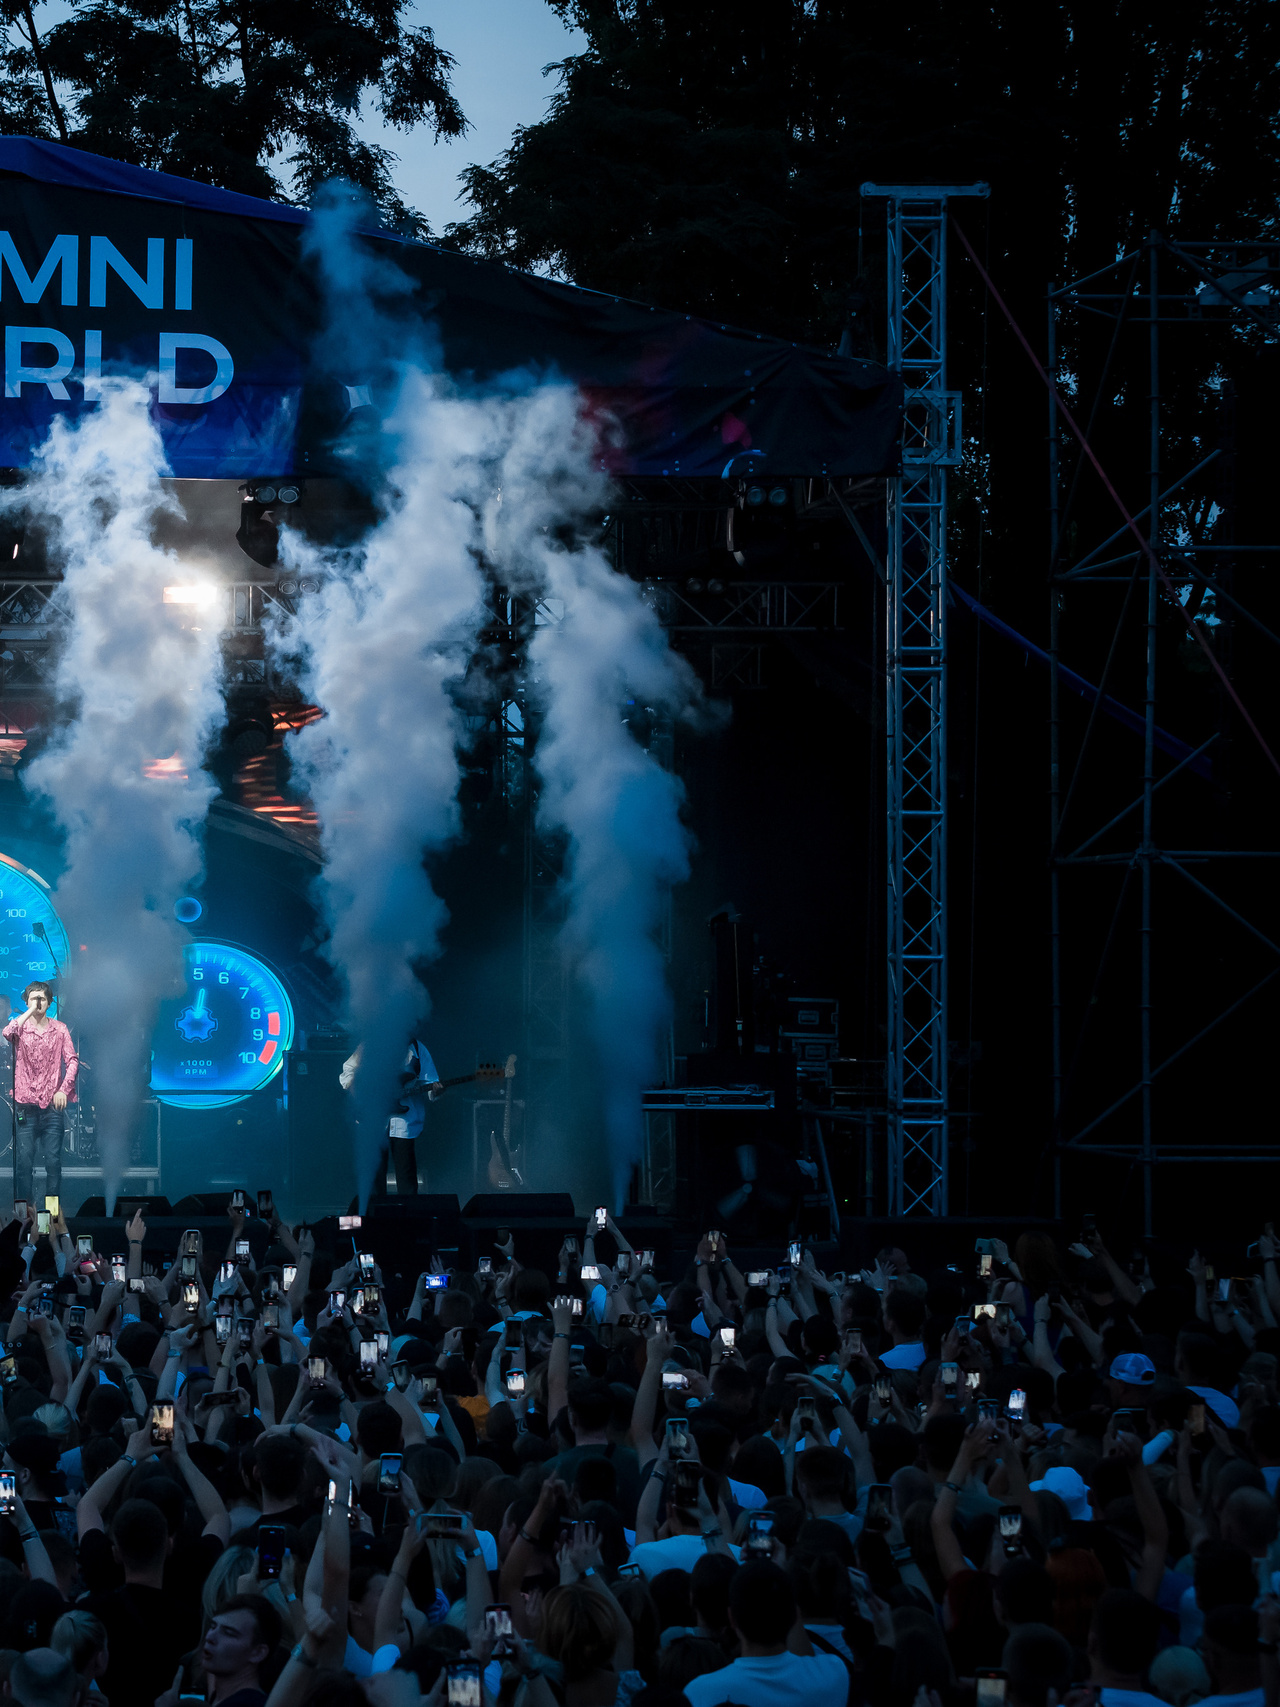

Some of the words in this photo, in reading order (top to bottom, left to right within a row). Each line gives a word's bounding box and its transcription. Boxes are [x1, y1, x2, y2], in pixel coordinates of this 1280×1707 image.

[5, 908, 27, 917] 100
[26, 961, 46, 971] 120
[193, 967, 204, 980] 5
[218, 971, 229, 984] 6
[239, 986, 250, 999] 7
[250, 1007, 261, 1019] 8
[252, 1028, 264, 1040] 9
[238, 1051, 257, 1064] 10
